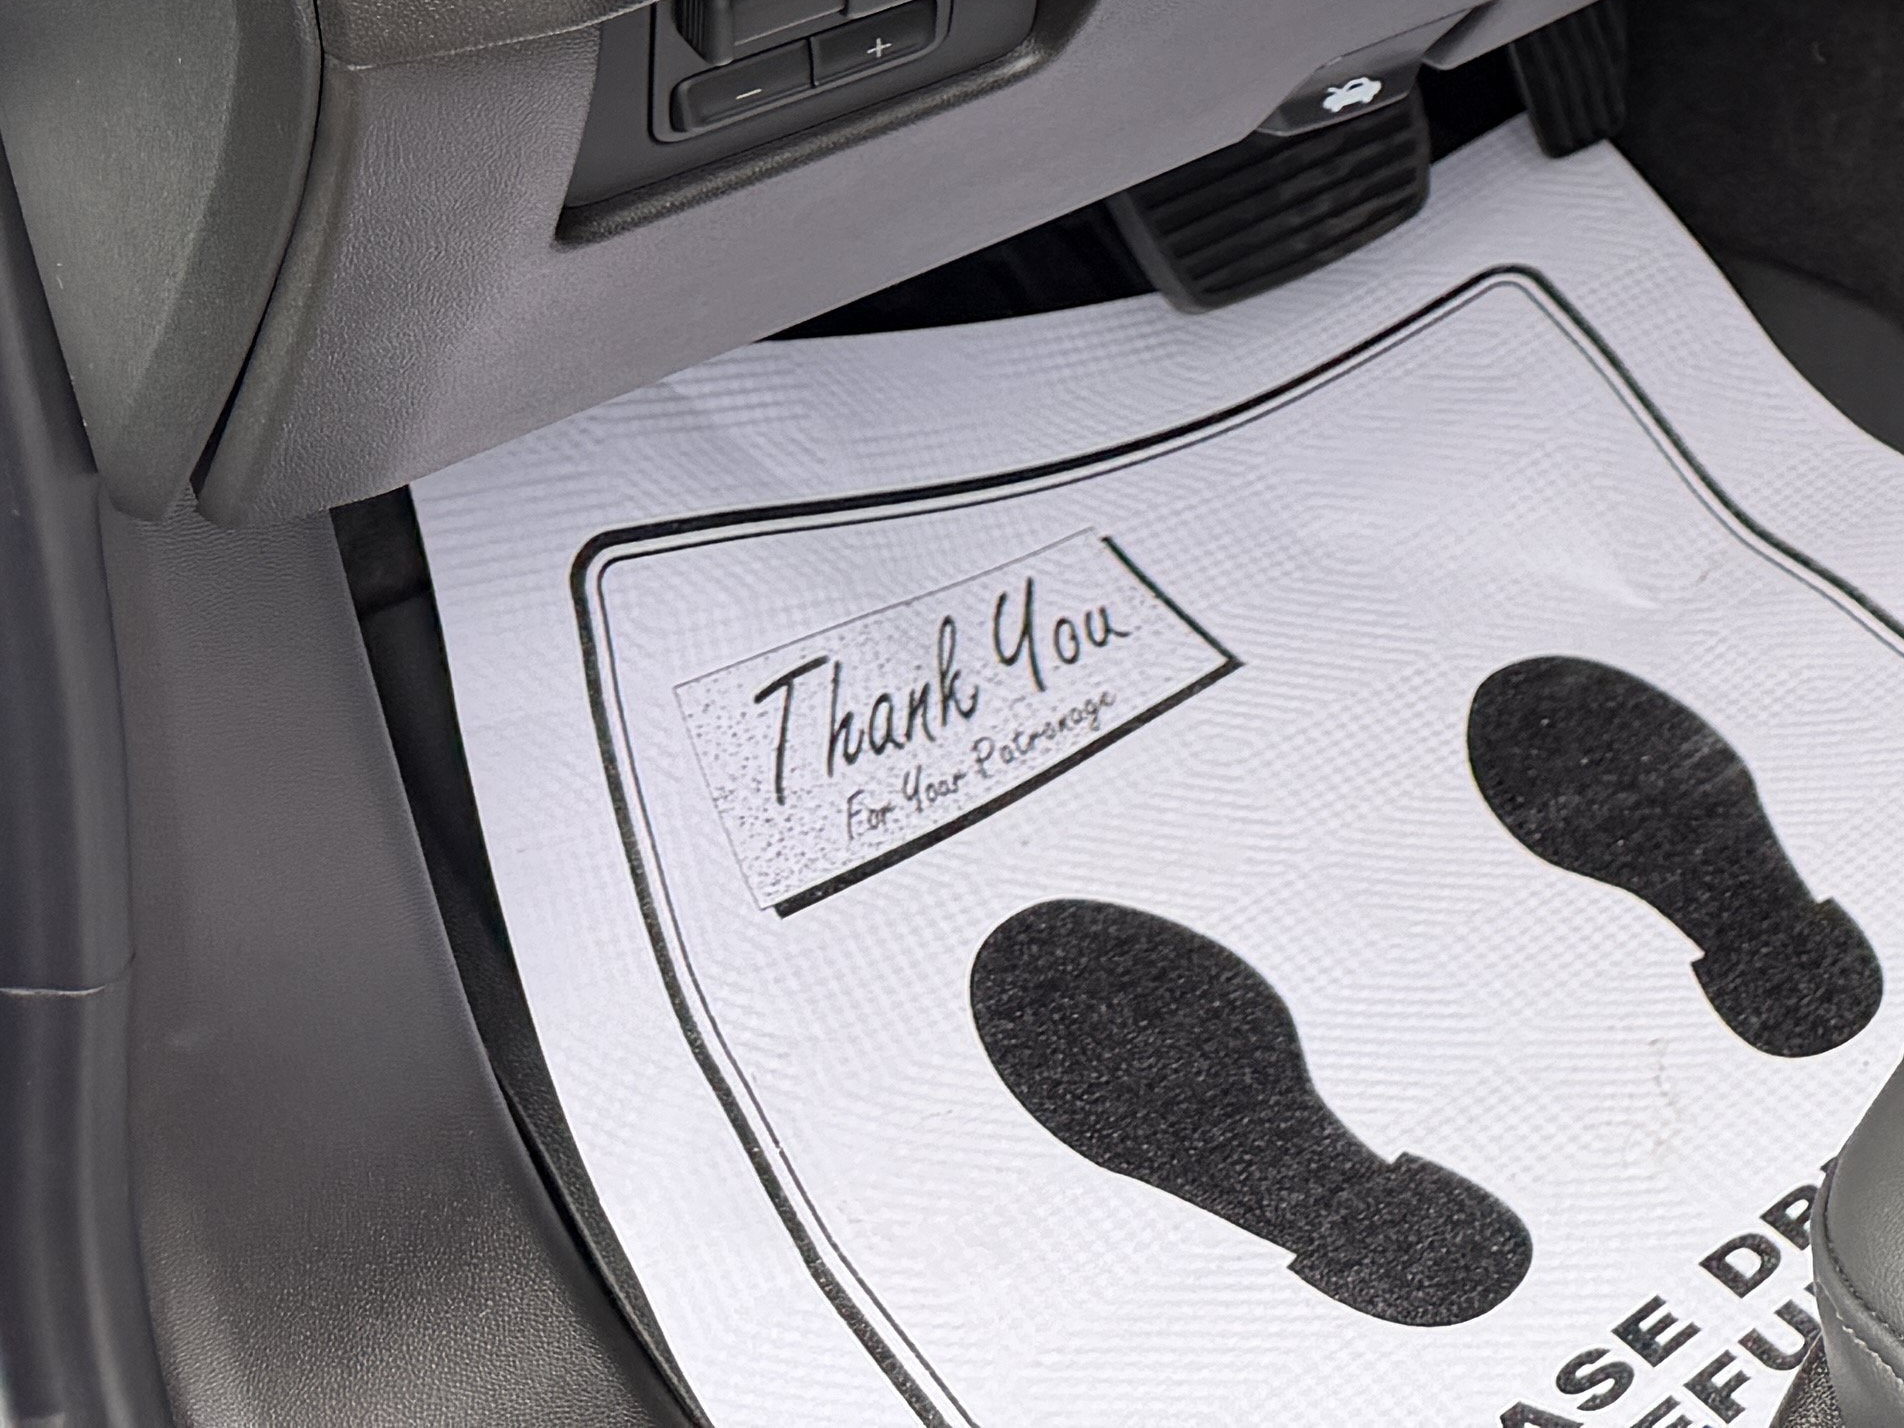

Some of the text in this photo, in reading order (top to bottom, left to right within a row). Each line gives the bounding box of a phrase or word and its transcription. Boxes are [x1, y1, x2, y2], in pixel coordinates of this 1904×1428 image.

[754, 577, 1130, 805] Thank You
[846, 690, 1117, 841] For Your Patronage
